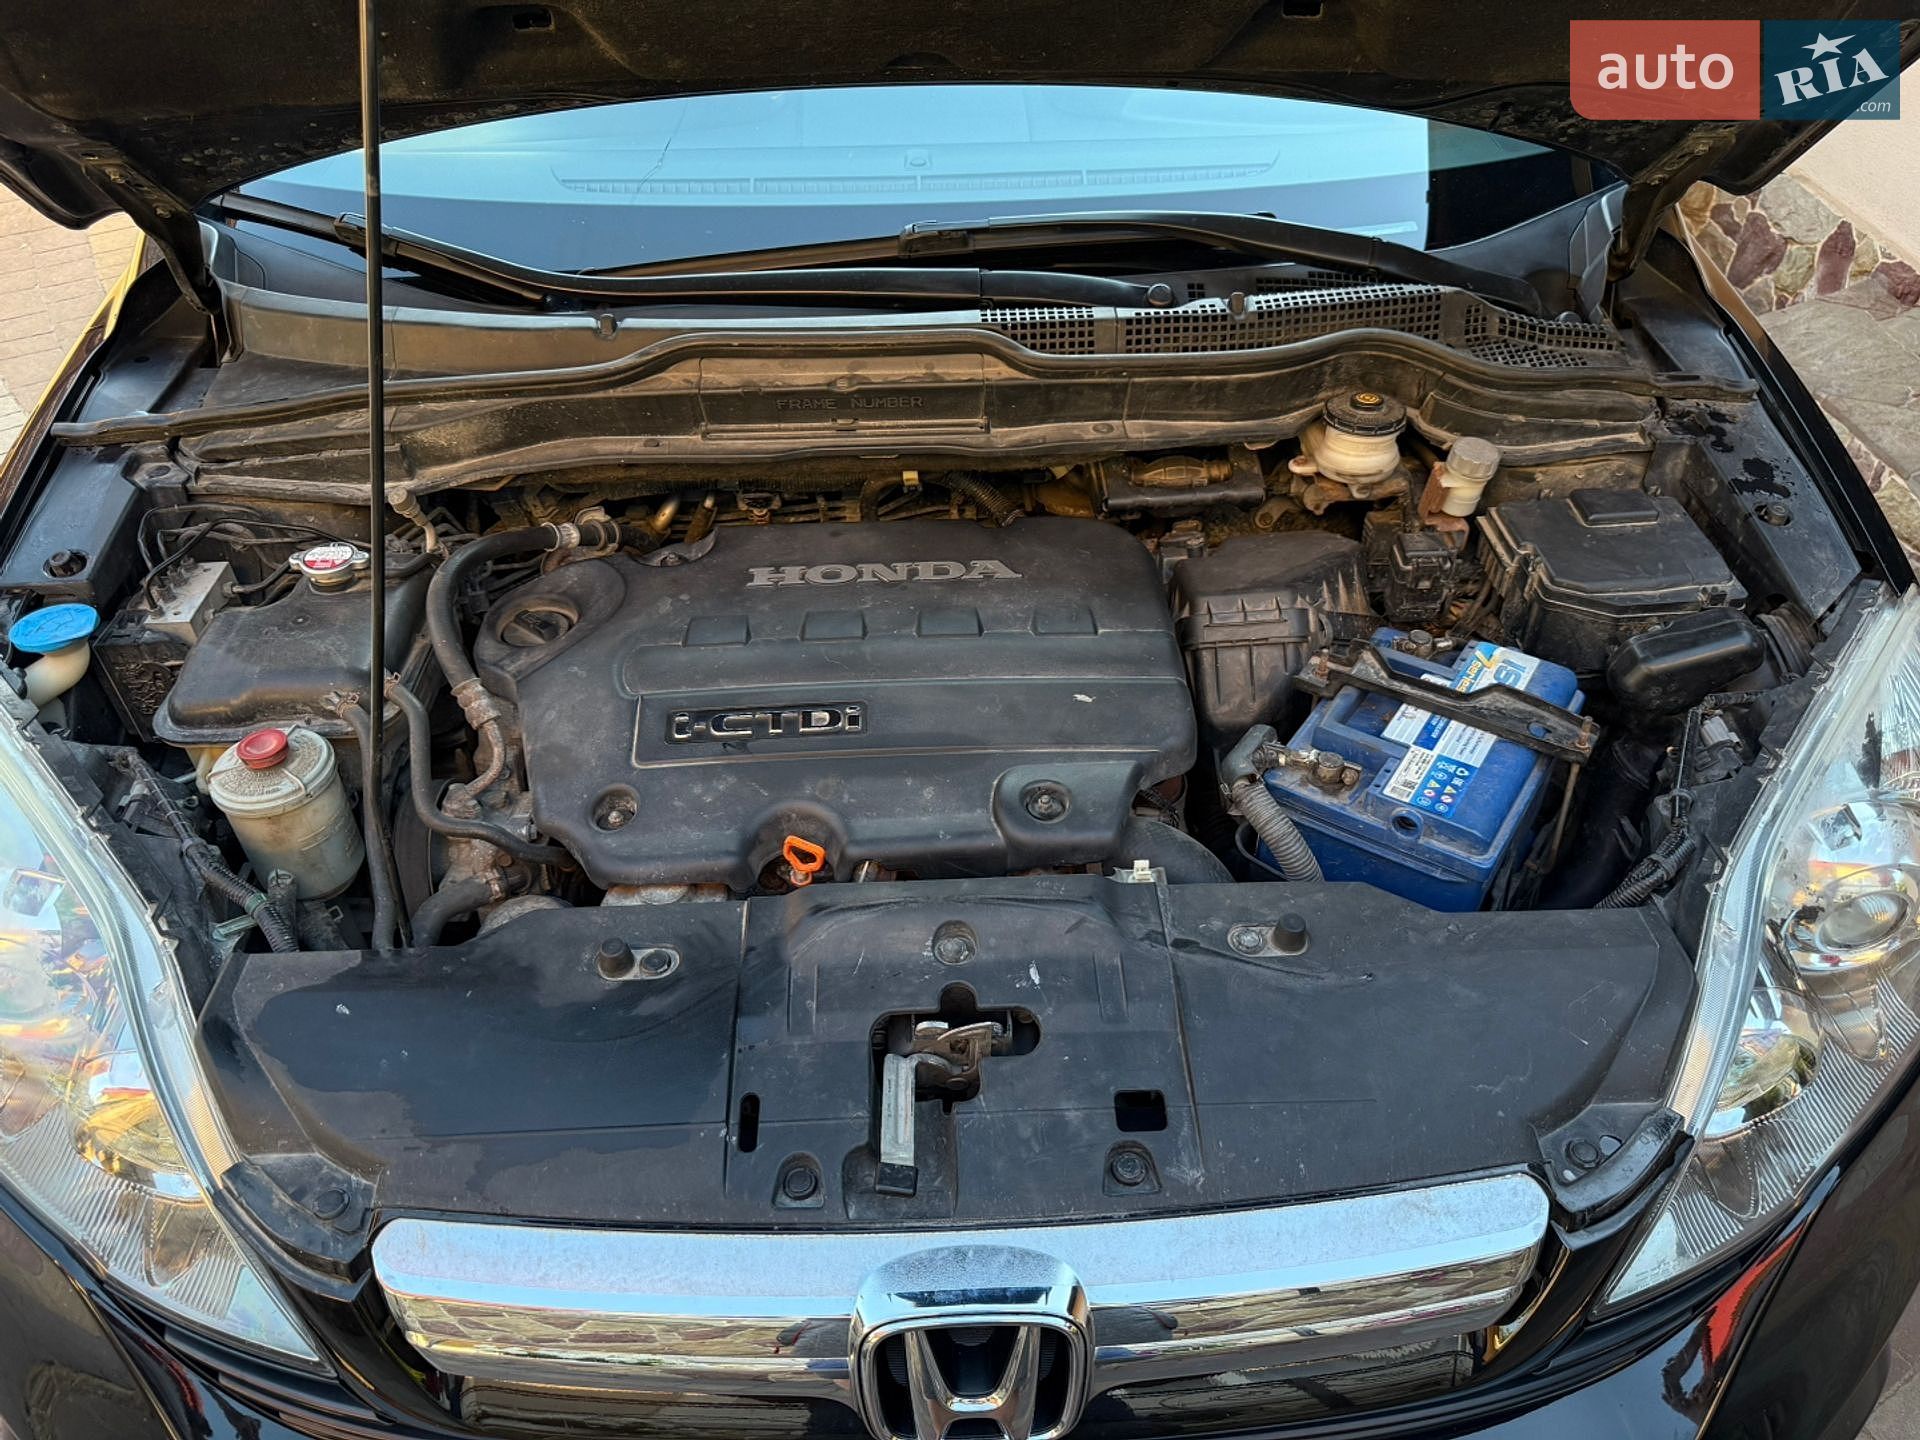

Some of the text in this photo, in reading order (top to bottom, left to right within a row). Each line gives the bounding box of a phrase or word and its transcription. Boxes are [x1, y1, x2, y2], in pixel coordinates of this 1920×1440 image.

[776, 396, 924, 410] FRAME NUMBER
[746, 559, 1023, 587] HONDA
